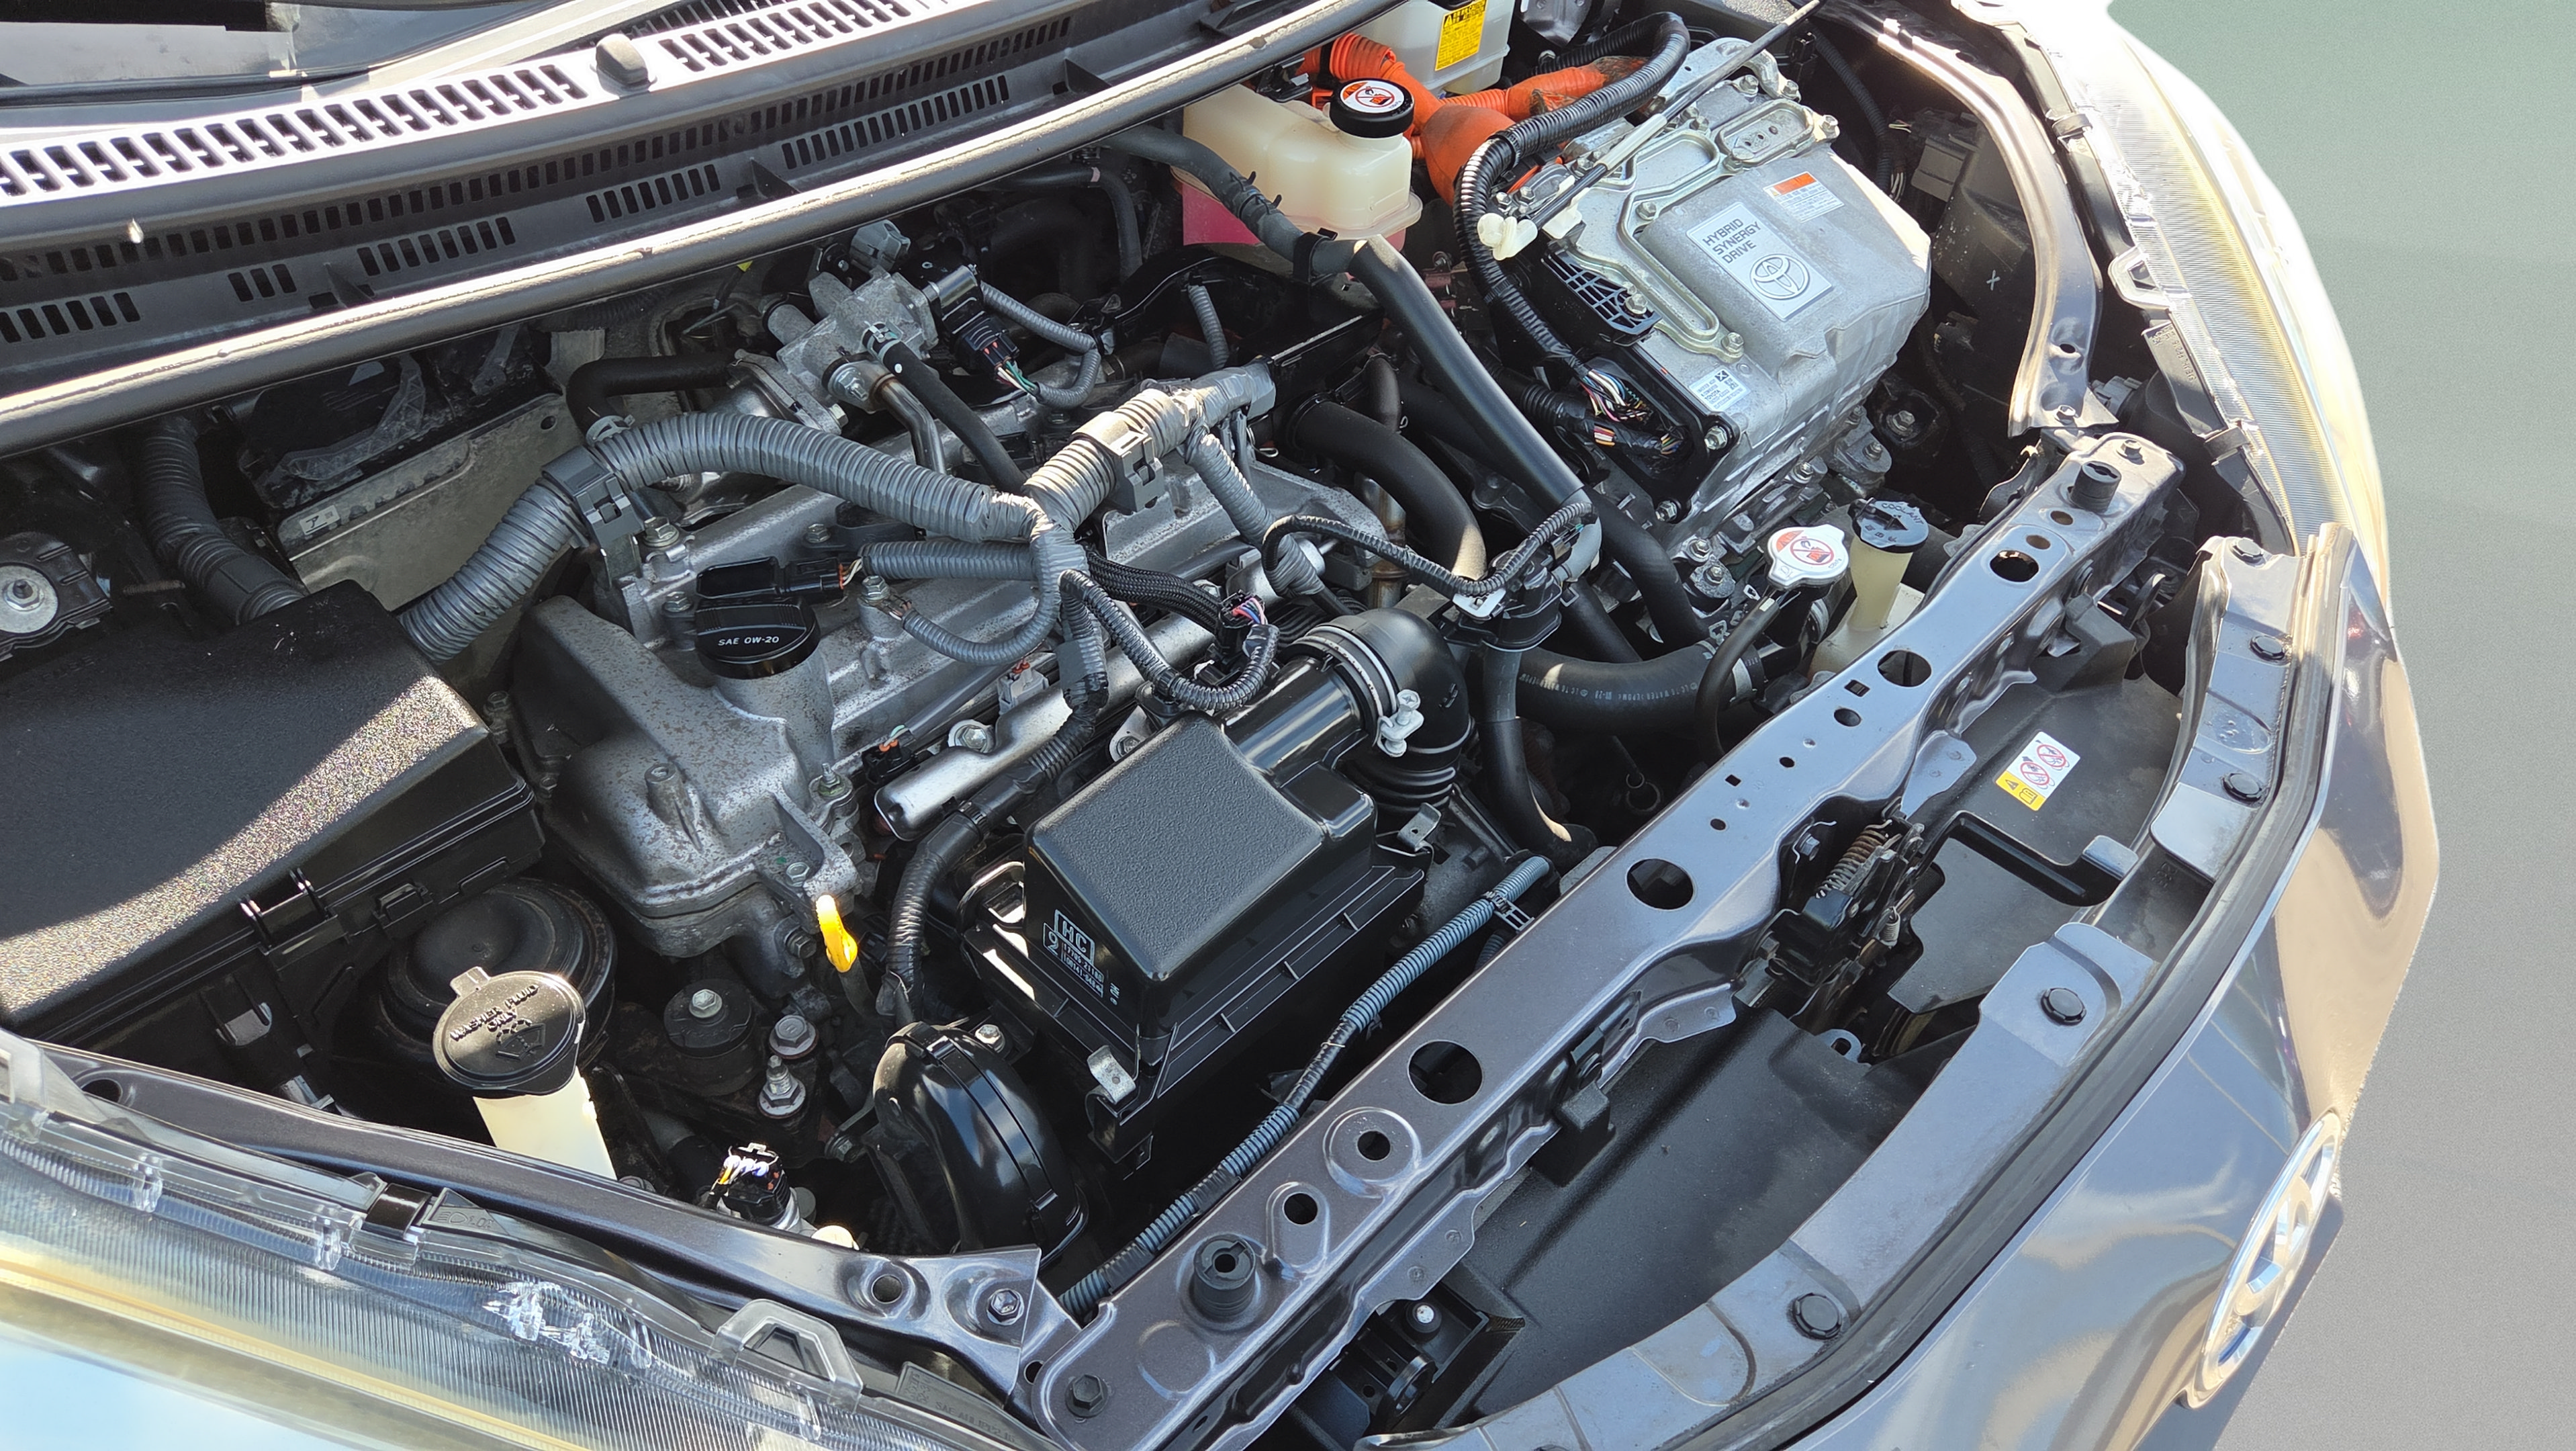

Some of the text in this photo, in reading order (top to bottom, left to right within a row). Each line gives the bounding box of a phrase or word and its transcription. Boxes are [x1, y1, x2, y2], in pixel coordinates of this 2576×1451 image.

[1702, 218, 1744, 246] HYBRID
[1712, 221, 1761, 255] SYNERGY
[1721, 240, 1757, 263] DRIVE
[1882, 502, 1924, 525] COOLANT
[718, 636, 780, 646] SAE 0W-20
[1062, 920, 1087, 953] HC
[450, 983, 539, 1041] WASHER FLUID
[487, 1007, 518, 1032] ONLY
